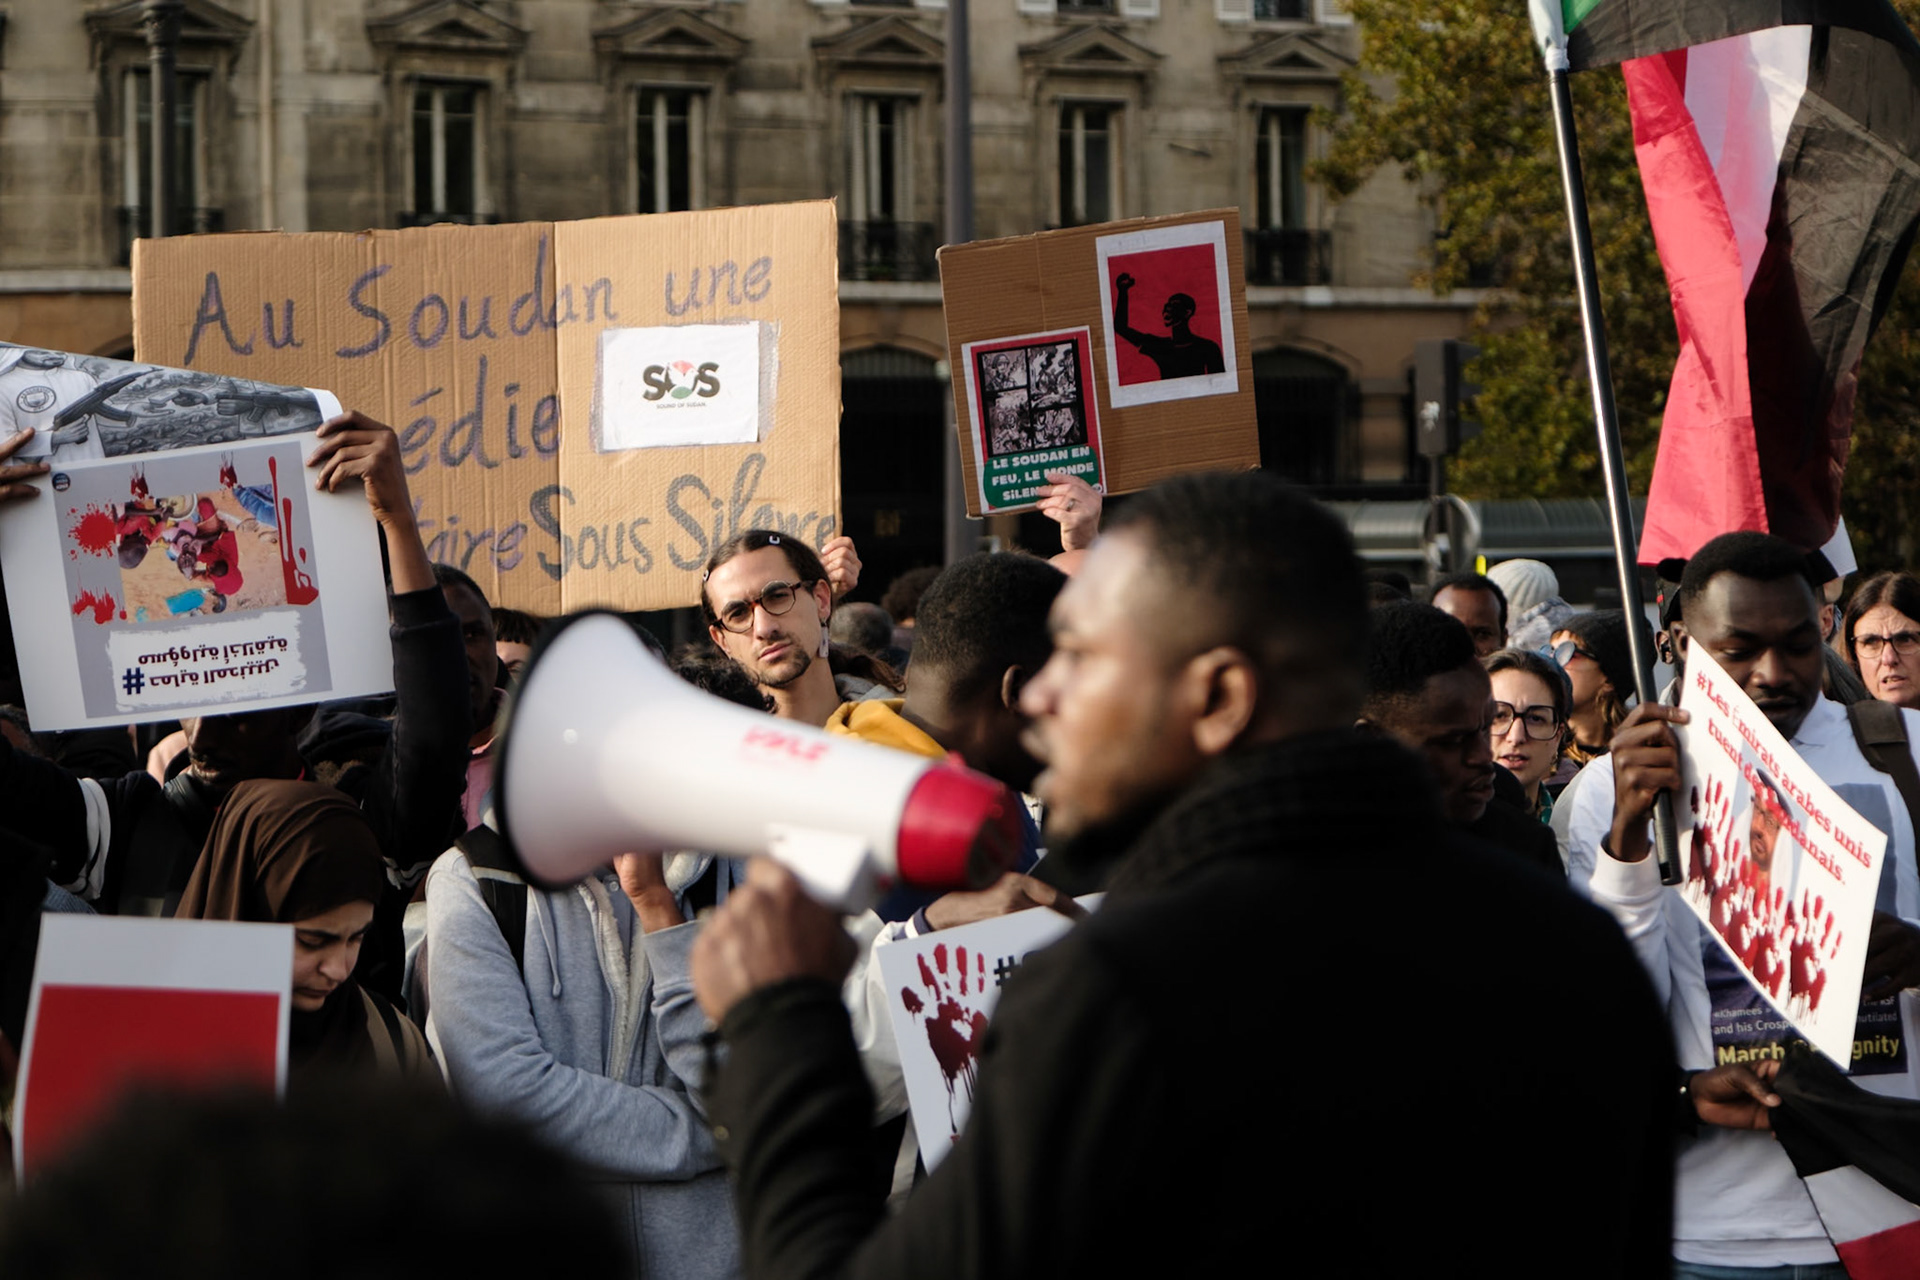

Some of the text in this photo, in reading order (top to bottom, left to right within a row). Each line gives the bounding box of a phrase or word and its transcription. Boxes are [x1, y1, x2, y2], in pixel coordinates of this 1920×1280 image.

[184, 231, 773, 365] Au Soudan une
[400, 354, 561, 475] édie
[992, 446, 1090, 469] LE SOUDAN EN
[992, 473, 1022, 486] FEU,
[1024, 470, 1041, 481] LE
[528, 484, 654, 581] Sous
[138, 636, 288, 667] مسؤولية أخلاقية
[203, 657, 280, 684] المدنيين
[1708, 718, 1743, 771] tuent
[1696, 670, 1872, 869] #Les Émirats arabes unis
[1714, 1023, 1734, 1035] and
[1736, 1021, 1753, 1033] his
[1718, 1041, 1785, 1066] March
[1852, 1034, 1900, 1060] gnity
